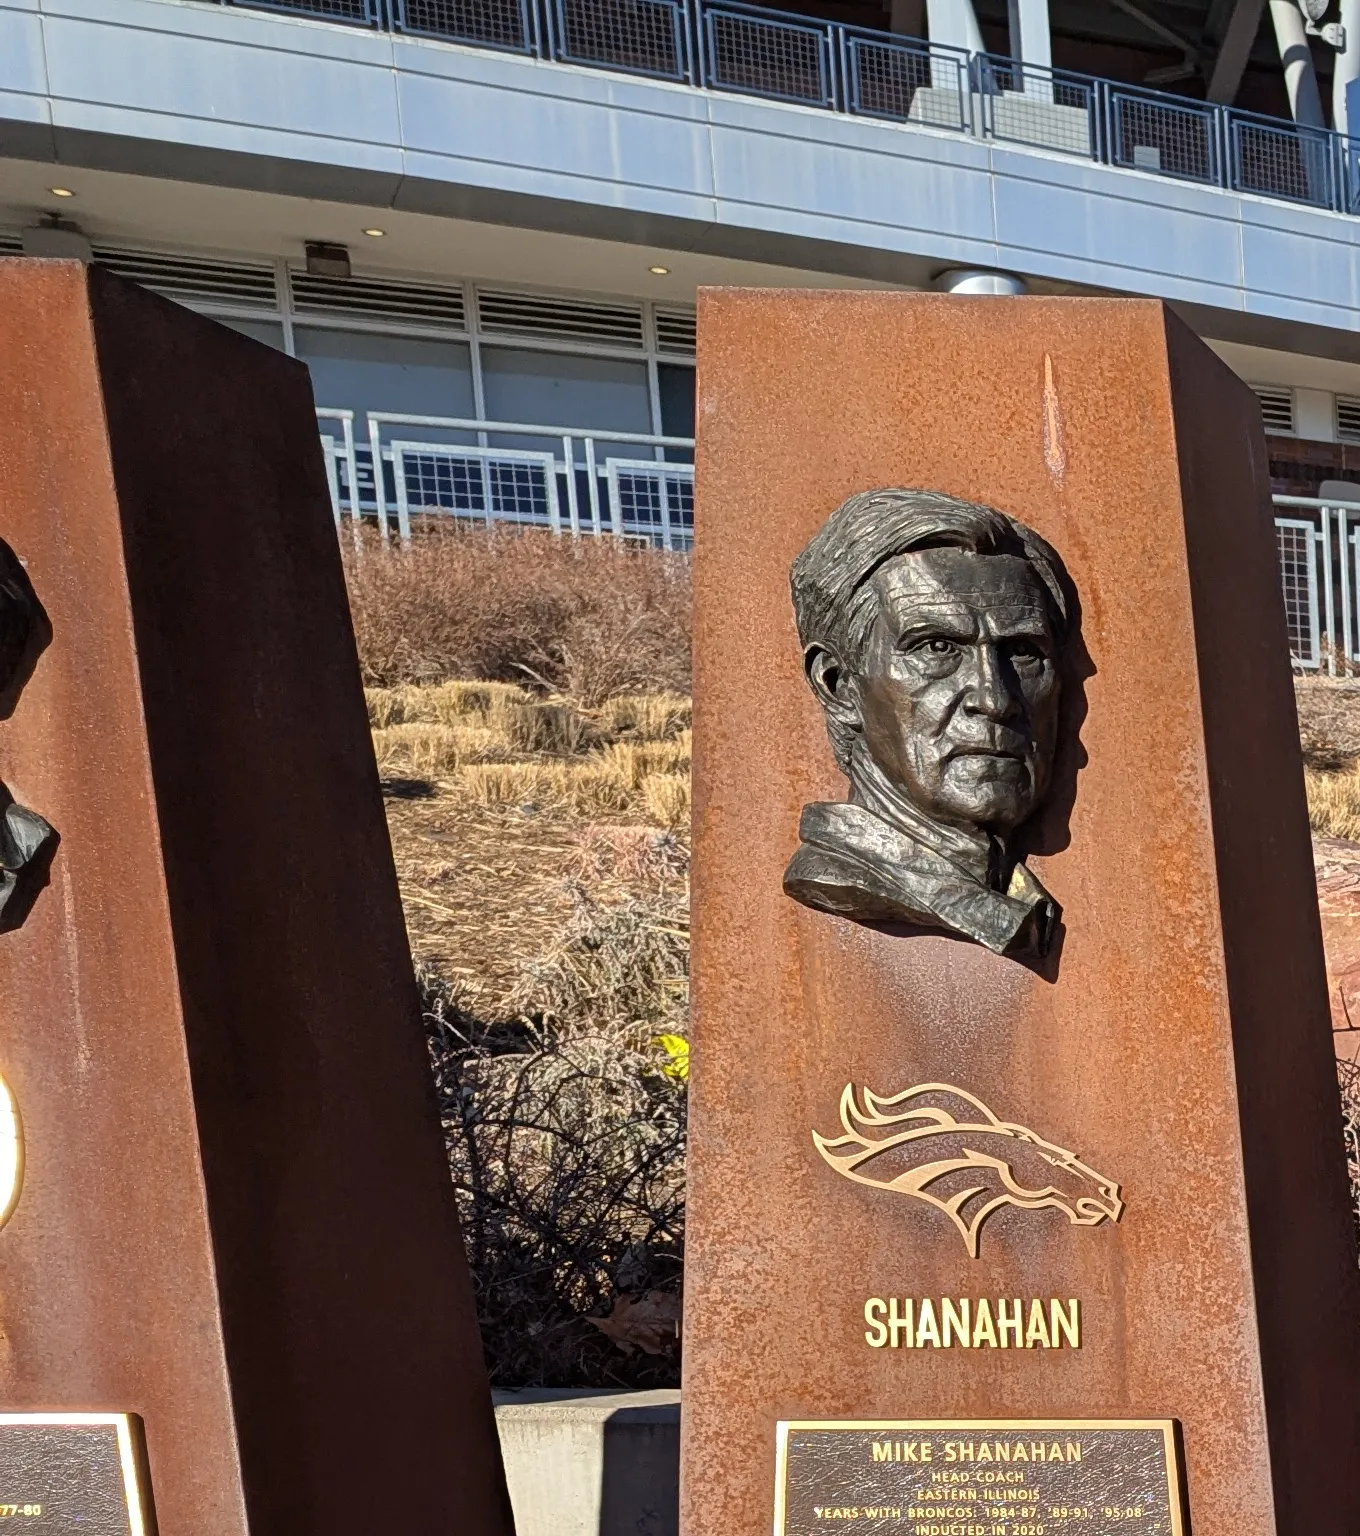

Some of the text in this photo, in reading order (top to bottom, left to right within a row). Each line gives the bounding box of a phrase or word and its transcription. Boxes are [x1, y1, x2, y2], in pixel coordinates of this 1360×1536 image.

[864, 1297, 1081, 1349] SHANAHAN
[872, 1442, 1083, 1462] MIKE SHANAHAN
[931, 1471, 1024, 1483] HEAD COACH
[917, 1488, 1040, 1500] EASTERN ILLINOIS
[815, 1507, 859, 1518] YEARS
[865, 1507, 900, 1518] WITH
[985, 1506, 1041, 1518] 1984-87,
[915, 1525, 1044, 1536] INDUCTED IN 2020
